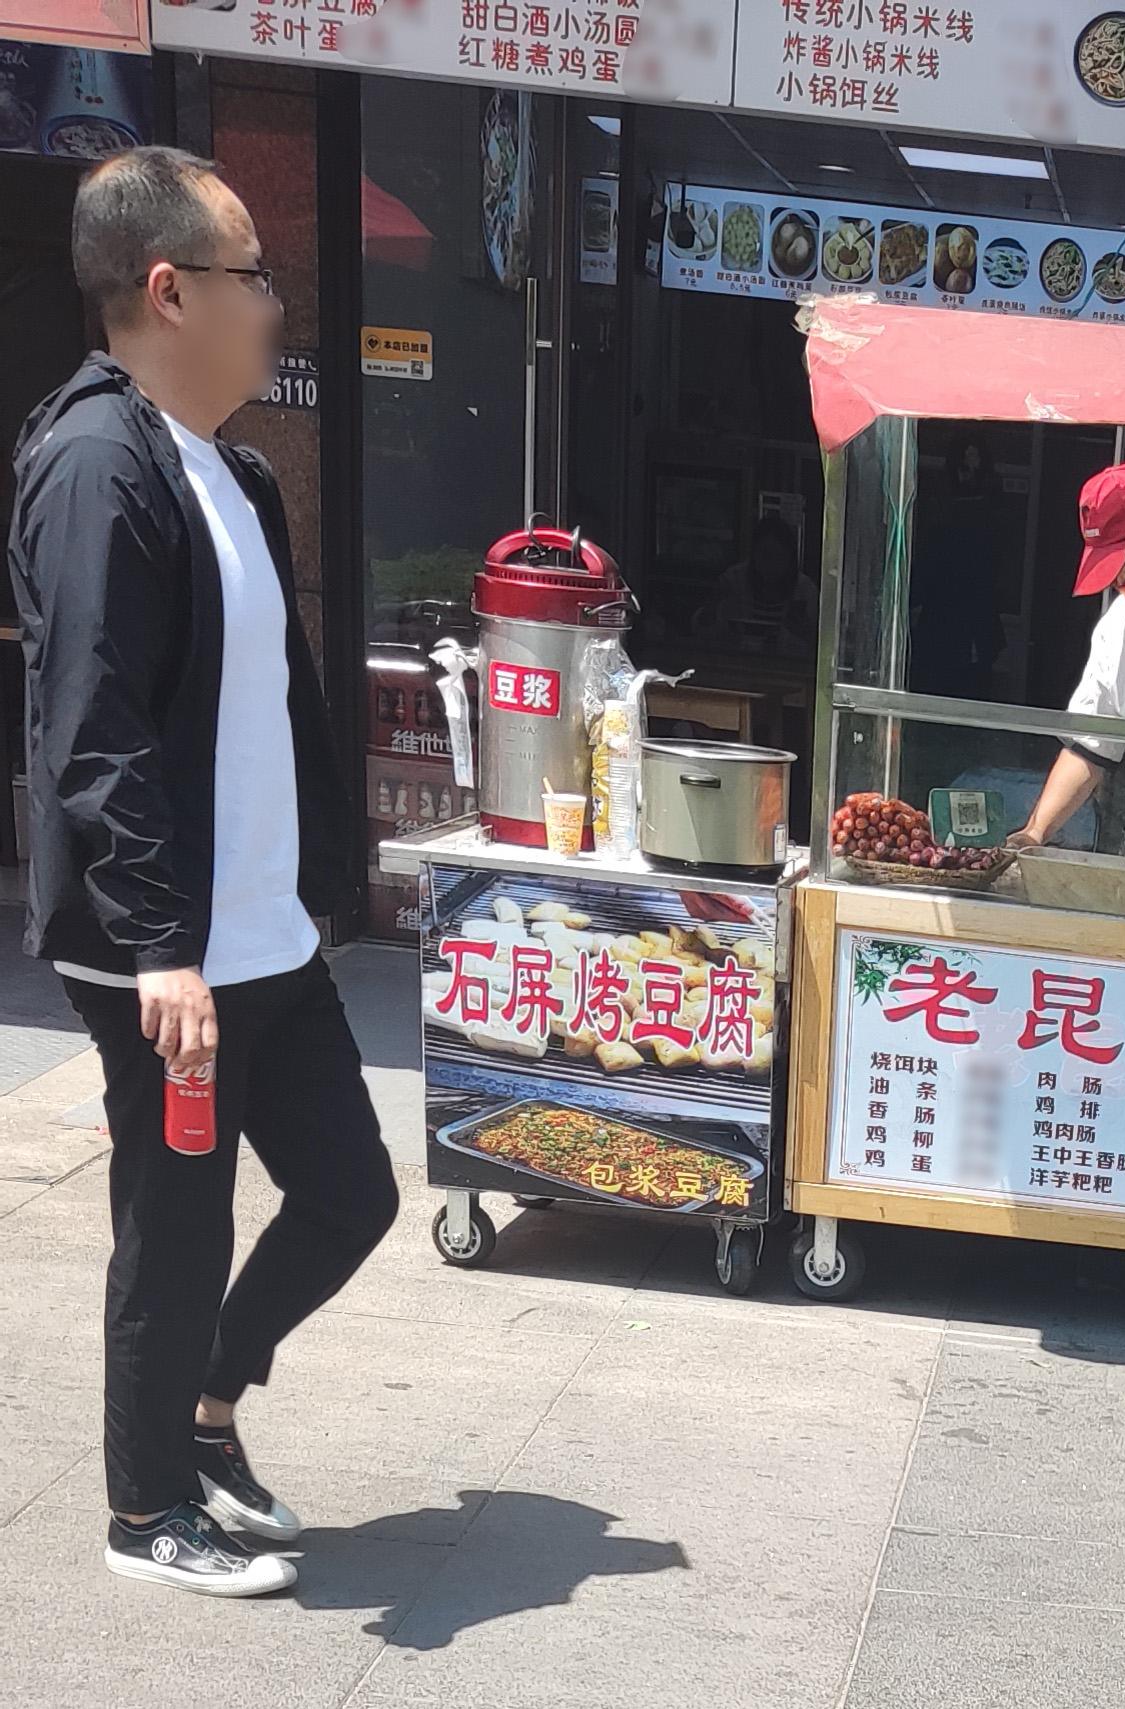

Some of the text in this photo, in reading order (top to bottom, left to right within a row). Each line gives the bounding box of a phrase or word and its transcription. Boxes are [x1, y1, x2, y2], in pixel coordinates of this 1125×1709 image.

[250, 11, 344, 51] 茶叶蛋
[461, 0, 639, 46] 甜白酒小汤圆
[782, 0, 974, 43] 传统小锅米线
[458, 34, 621, 84] 红糖煮鸡蛋
[782, 30, 940, 80] 炸酱小锅米线
[776, 70, 900, 113] 小锅饵丝
[260, 376, 318, 407] 6110
[494, 670, 552, 709] 豆浆
[391, 729, 454, 758] 維他
[435, 938, 763, 1060] 石屏烤豆腐
[870, 1051, 938, 1077] 烧饵块
[1032, 1119, 1096, 1144] 鸡肉肠
[584, 1163, 754, 1207] 包浆豆腐
[1028, 1167, 1113, 1194] 洋芋粑粑
